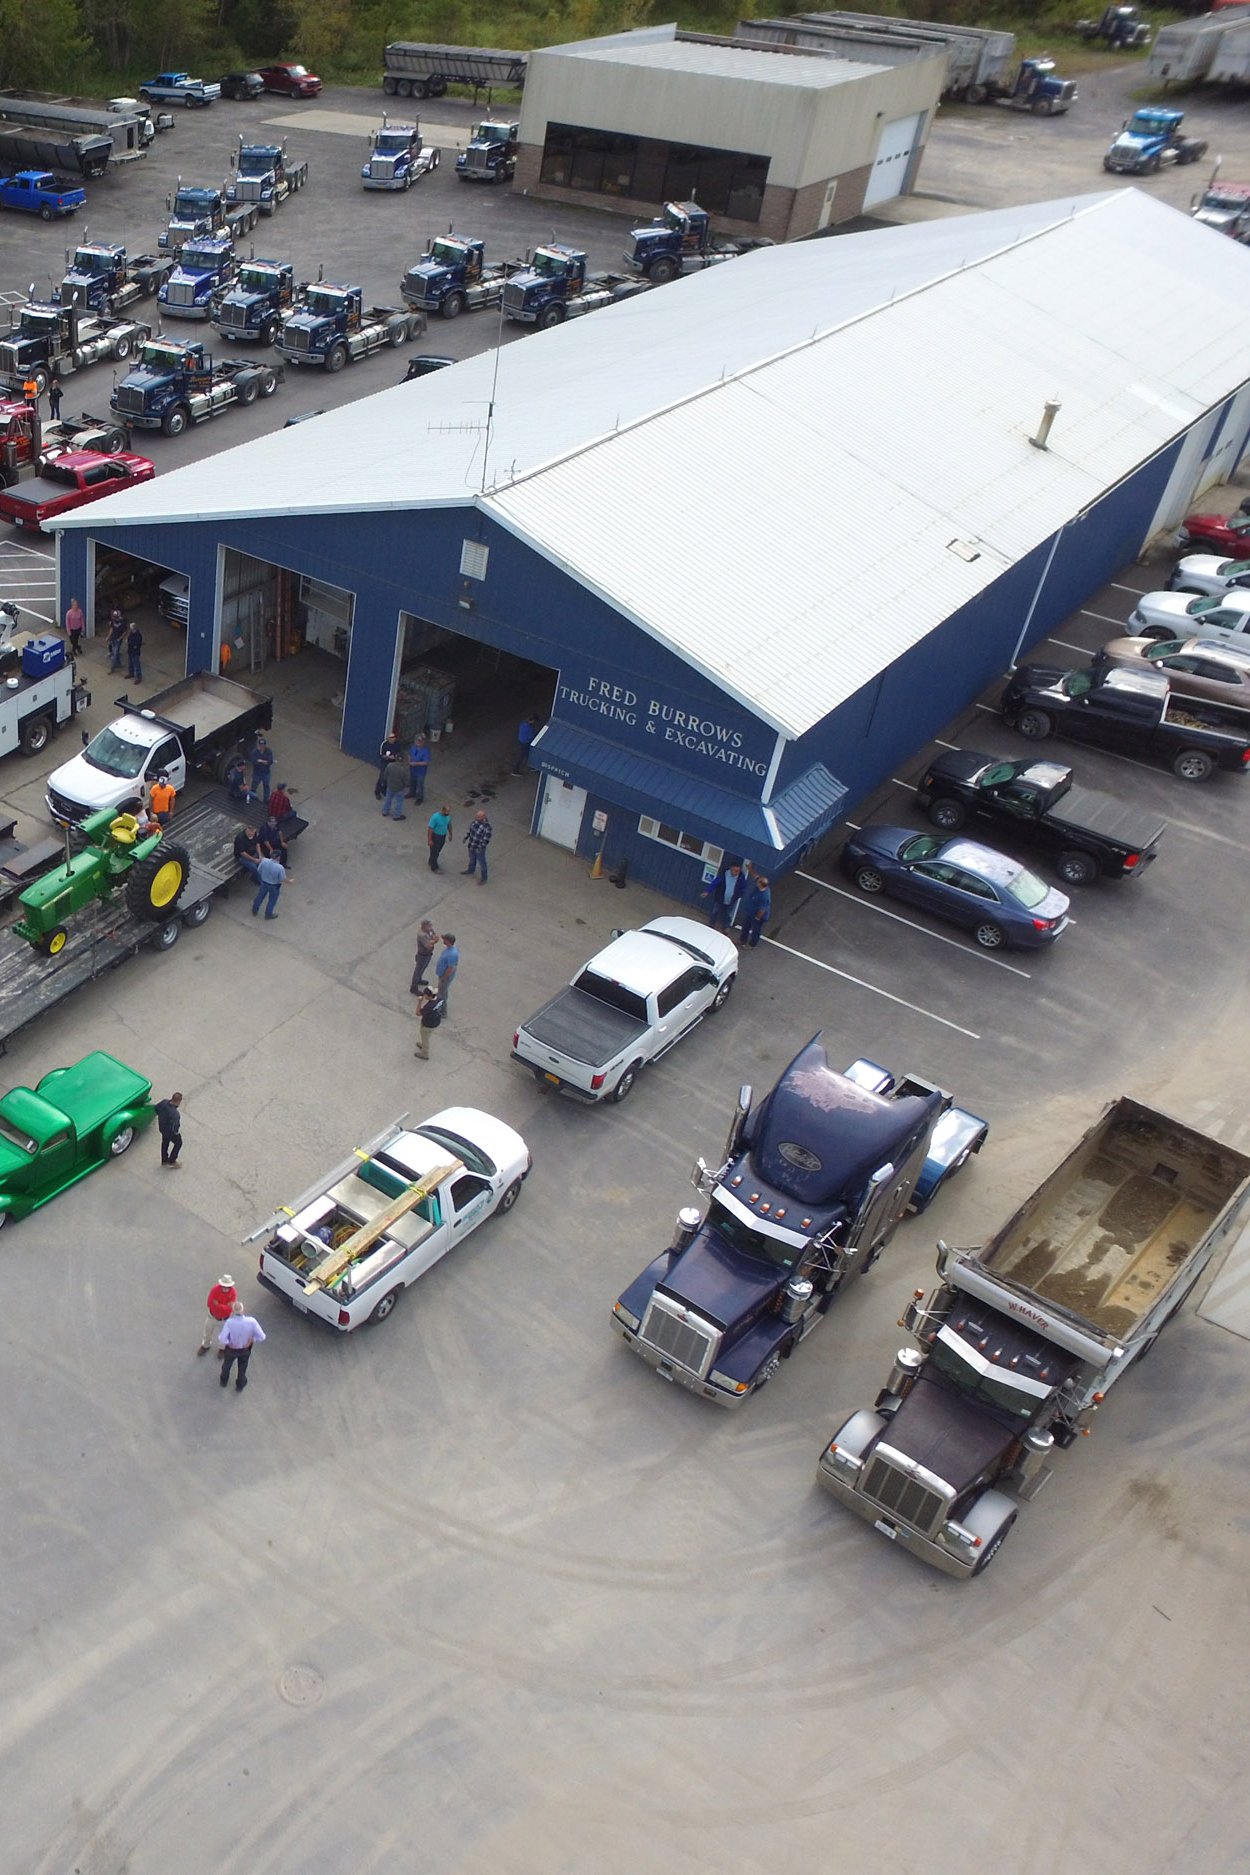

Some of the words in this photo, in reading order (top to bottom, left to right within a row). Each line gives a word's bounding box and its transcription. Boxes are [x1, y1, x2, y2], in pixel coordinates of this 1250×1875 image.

[560, 686, 637, 726] TRUCKING
[645, 720, 657, 735] &
[664, 727, 767, 777] EXCAVATING
[588, 676, 638, 707] FRED
[647, 700, 743, 748] BURROWS
[541, 761, 571, 778] DISPATCH
